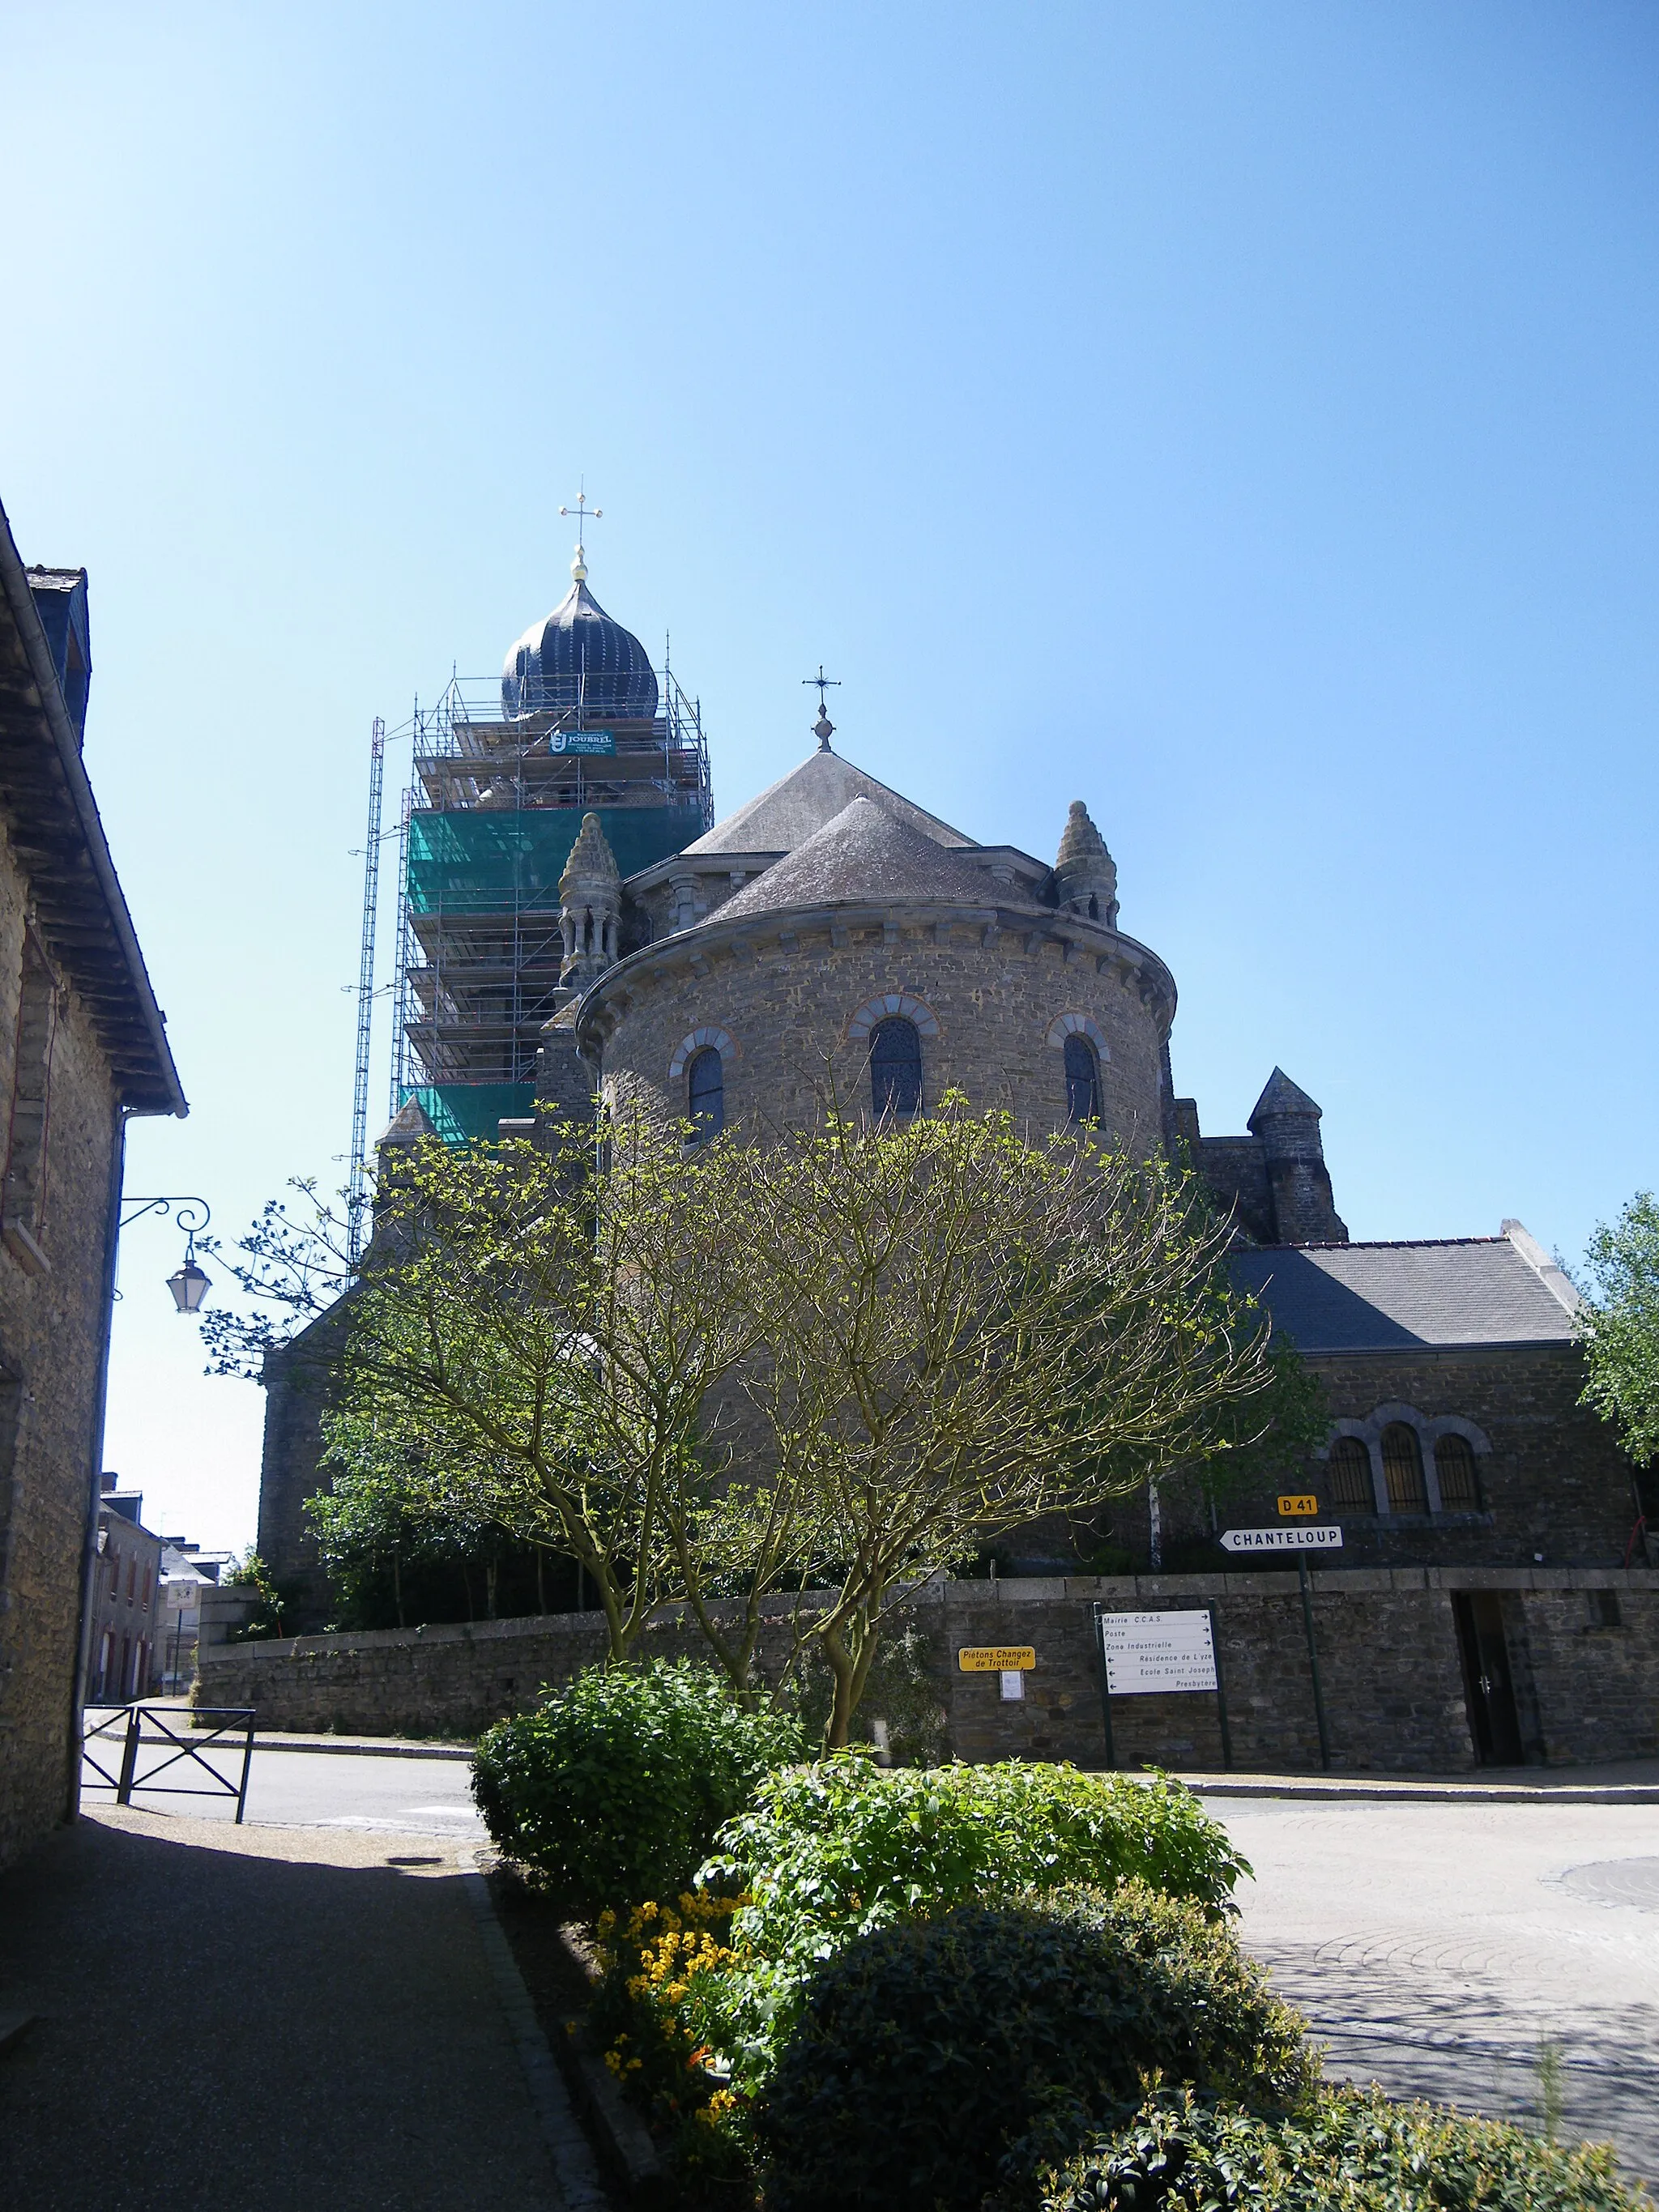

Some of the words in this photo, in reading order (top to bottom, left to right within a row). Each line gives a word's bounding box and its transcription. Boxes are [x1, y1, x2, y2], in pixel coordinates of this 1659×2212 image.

[1283, 1500, 1291, 1511] D
[1297, 1499, 1311, 1511] 41
[1233, 1531, 1337, 1546] CHANTELOUP
[1128, 1642, 1172, 1650] Industrielle
[963, 1651, 993, 1659] Piétons
[996, 1650, 1031, 1660] Changez
[988, 1659, 1019, 1667] Trottoir
[1188, 1666, 1215, 1674] Joseph
